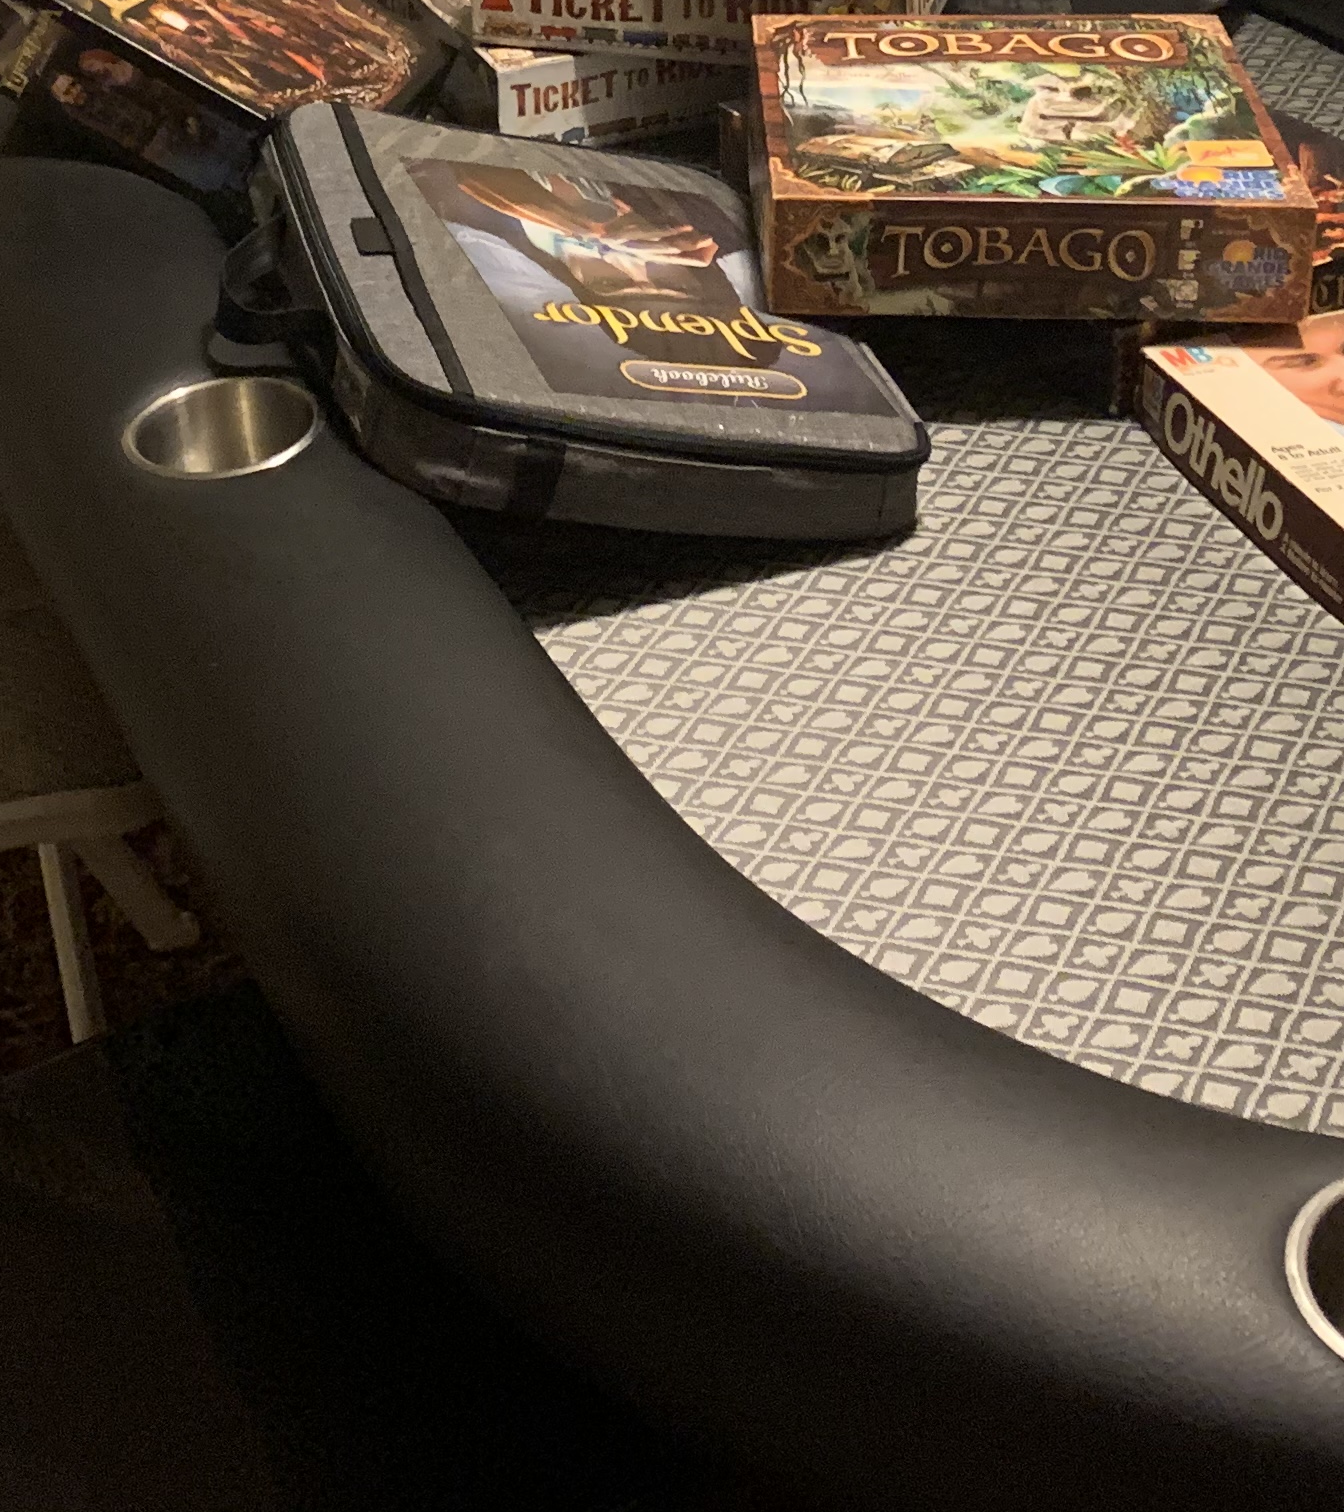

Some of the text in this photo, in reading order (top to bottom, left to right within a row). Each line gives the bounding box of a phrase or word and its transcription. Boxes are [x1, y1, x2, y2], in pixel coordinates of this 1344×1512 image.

[824, 32, 1175, 62] TOBAGO
[510, 69, 618, 117] TICKET
[624, 67, 650, 91] TO
[881, 225, 1156, 282] TOBAGO
[534, 300, 822, 361] Splendor
[650, 368, 769, 391] Rulebook
[1159, 346, 1213, 368] MB
[1164, 392, 1284, 541] Othello
